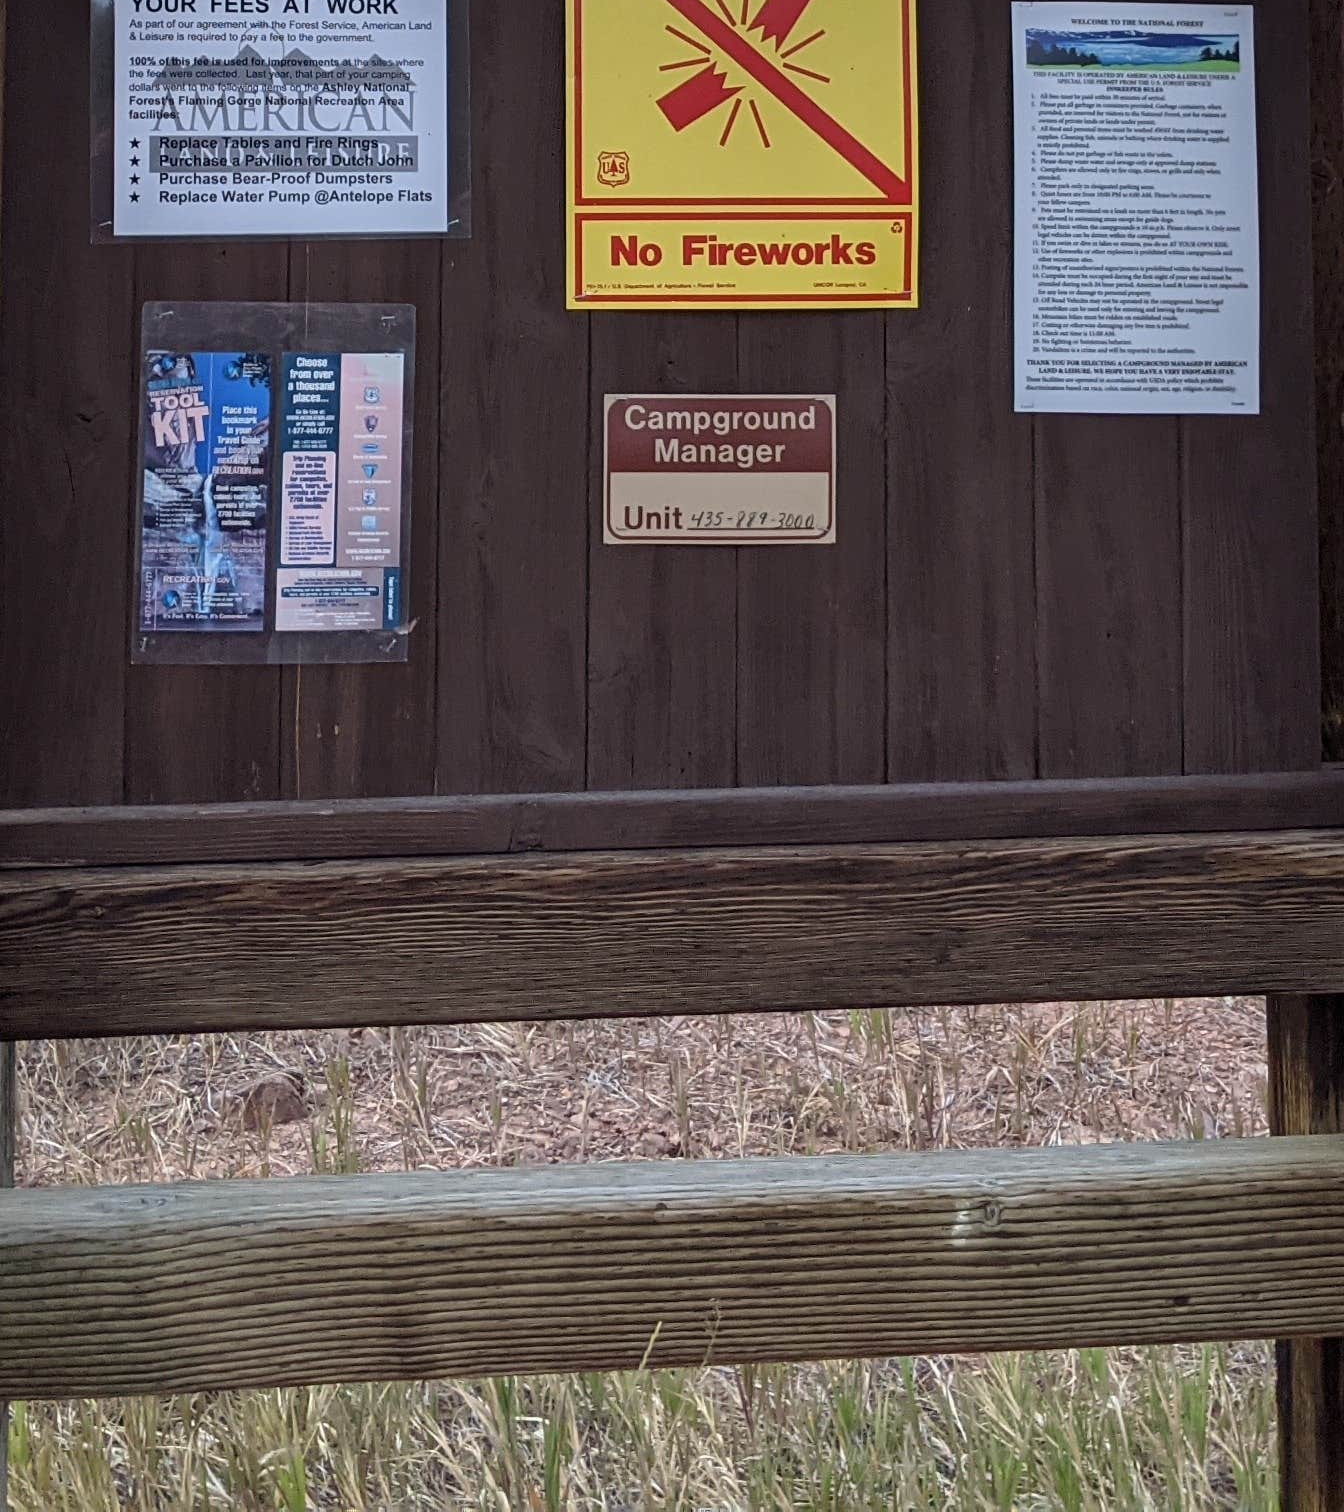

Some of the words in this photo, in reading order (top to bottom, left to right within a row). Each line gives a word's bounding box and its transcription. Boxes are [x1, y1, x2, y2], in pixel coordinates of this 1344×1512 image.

[129, 19, 143, 29] As
[145, 20, 164, 30] part
[166, 19, 176, 29] of
[177, 21, 195, 29] our
[196, 20, 247, 31] agreement
[271, 20, 287, 29] the
[289, 20, 319, 30] Forest
[321, 20, 360, 31] Service,
[362, 21, 407, 30] American
[409, 21, 432, 30] Land
[129, 32, 136, 41] &
[139, 32, 174, 41] Leisure
[176, 32, 185, 41] is
[187, 32, 227, 43] required
[229, 33, 239, 41] to
[240, 33, 258, 43] pay
[269, 33, 285, 41] fee
[287, 33, 297, 42] to
[298, 33, 314, 42] the
[129, 56, 156, 66] 100%
[158, 56, 169, 66] of
[171, 56, 191, 66] this
[211, 56, 221, 66] is
[223, 56, 248, 66] used
[251, 56, 265, 66] for
[268, 56, 340, 69] improvements
[396, 58, 424, 67] where
[129, 69, 144, 78] the
[169, 71, 193, 79] were
[246, 69, 267, 79] Last
[295, 70, 313, 79] that
[315, 70, 334, 80] part
[336, 70, 346, 79] of
[349, 71, 369, 81] your
[371, 70, 411, 81] camping
[321, 83, 360, 95] Ashley
[363, 83, 410, 93] National
[179, 96, 225, 108] Flaming
[227, 96, 262, 108] Gorge
[265, 96, 312, 106] National
[315, 97, 376, 107] Recreation
[378, 97, 406, 107] Area
[151, 86, 416, 133] AMERICAN
[159, 137, 218, 152] Replace
[221, 137, 270, 149] Tables
[274, 137, 301, 149] and
[305, 137, 333, 149] Fire
[337, 137, 379, 152] Rings
[159, 155, 228, 167] Purchase
[232, 157, 240, 167] a
[245, 155, 303, 167] Pavilion
[307, 155, 327, 167] for
[332, 155, 374, 167] Dutch
[377, 155, 414, 167] John
[159, 173, 228, 185] Purchase
[232, 173, 311, 185] Bear-Proof
[315, 173, 393, 186] Dumpsters
[159, 190, 218, 205] Replace
[222, 190, 264, 203] Water
[268, 191, 310, 205] Pump
[315, 190, 394, 205] @Antelope
[398, 190, 433, 202] Flats
[610, 235, 662, 266] No
[682, 234, 876, 266] Fireworks
[296, 356, 328, 368] Choose
[150, 392, 205, 411] TOOL
[151, 406, 210, 447] KIT
[624, 405, 816, 435] Campground
[655, 438, 786, 468] Manager
[624, 505, 682, 530] Unit
